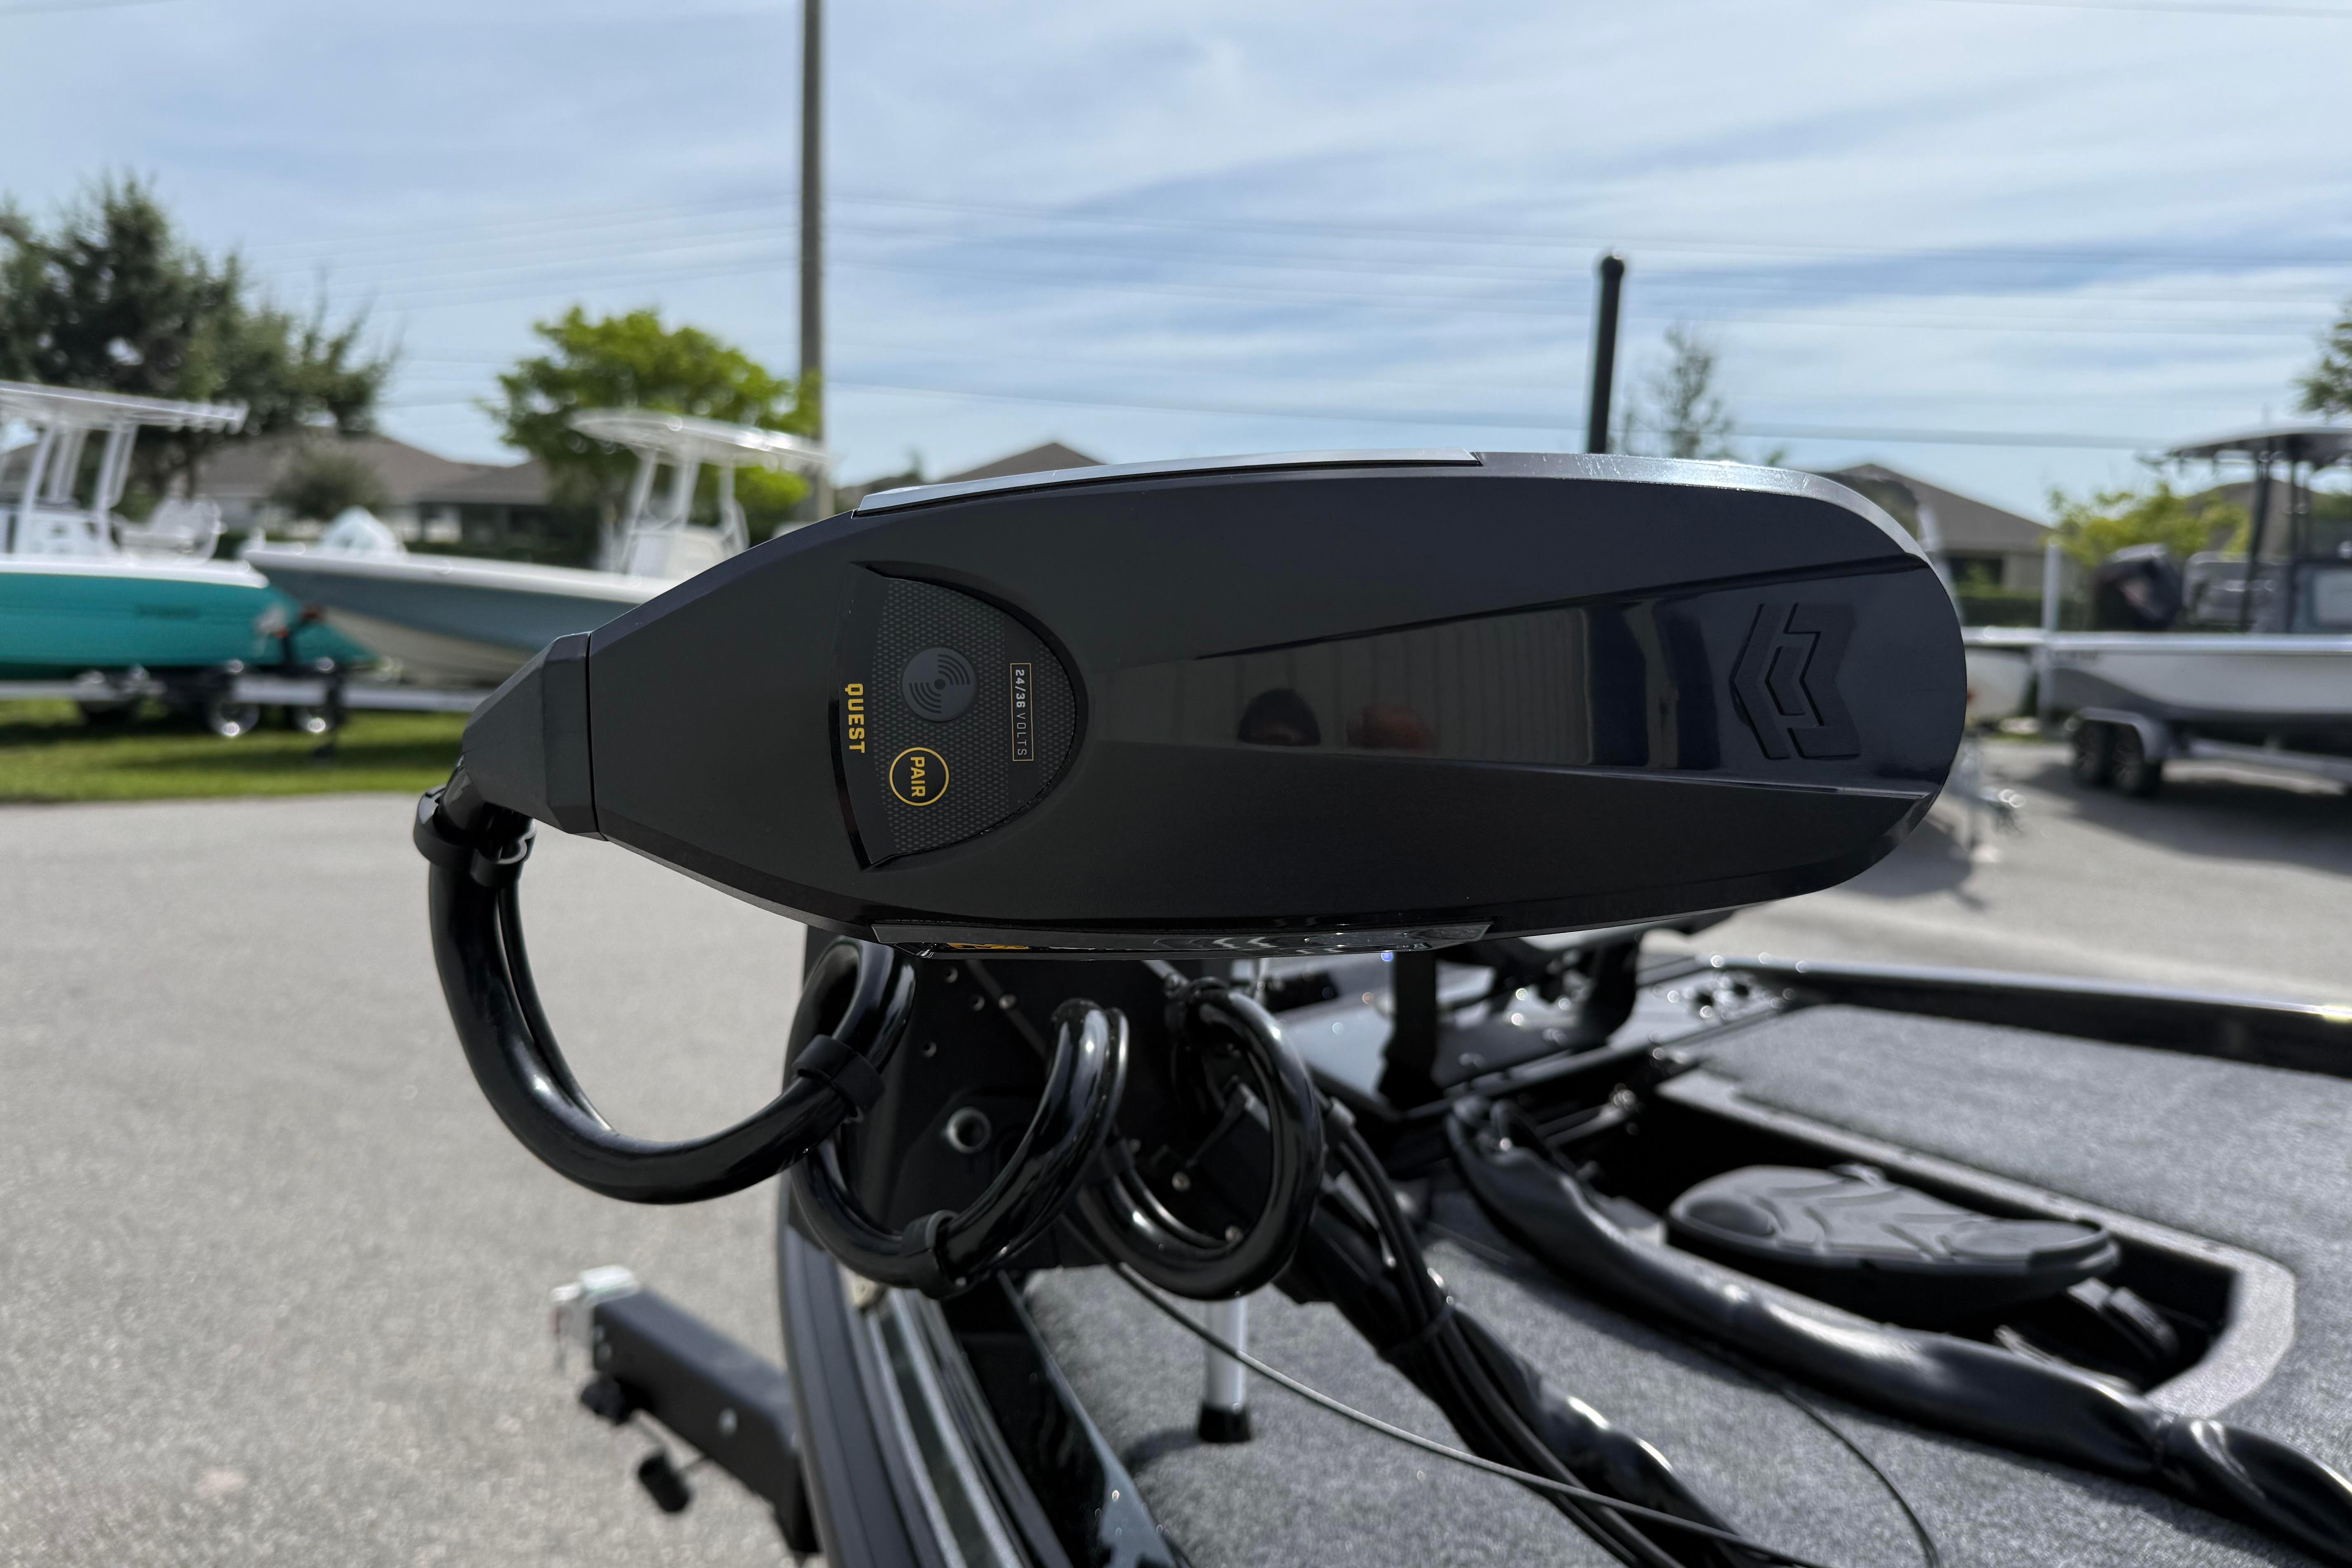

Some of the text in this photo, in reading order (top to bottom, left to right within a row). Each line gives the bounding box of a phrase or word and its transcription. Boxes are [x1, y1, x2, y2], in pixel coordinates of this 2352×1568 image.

[844, 683, 866, 754] QUEST
[1015, 669, 1027, 756] 24/36 VOLTS
[910, 756, 926, 797] PAIR
